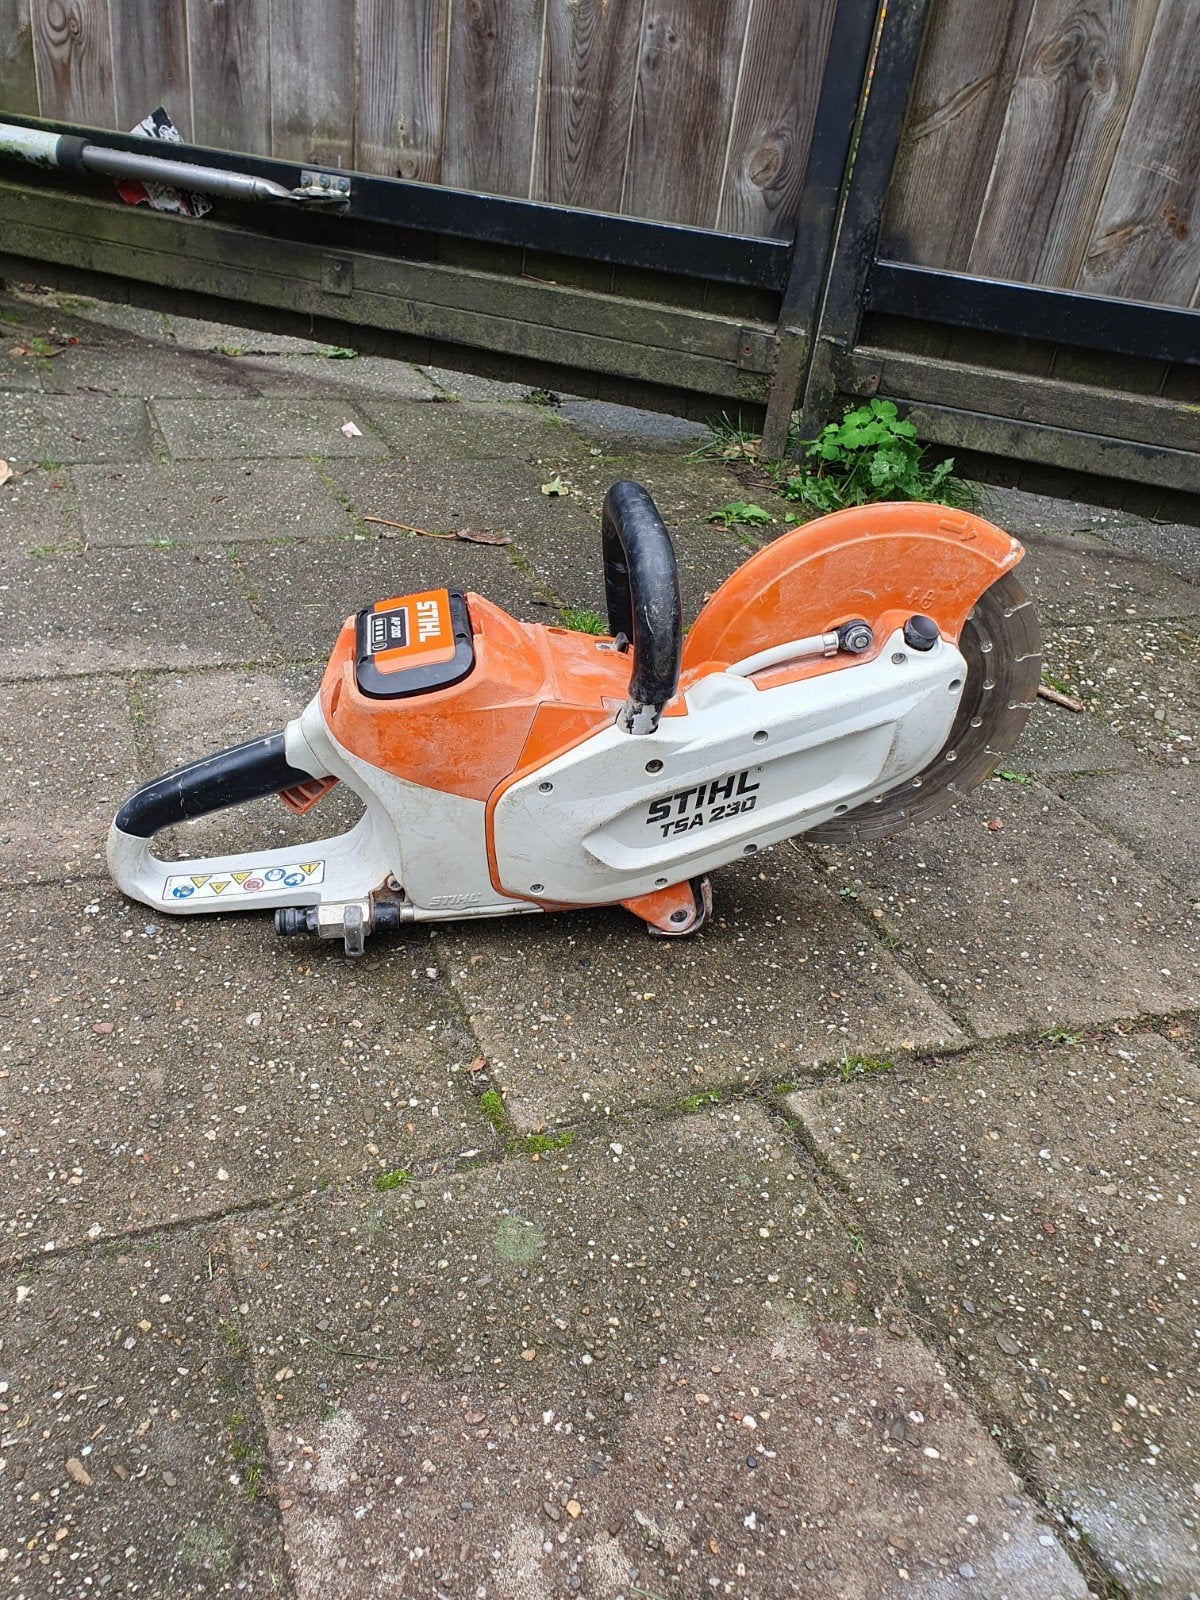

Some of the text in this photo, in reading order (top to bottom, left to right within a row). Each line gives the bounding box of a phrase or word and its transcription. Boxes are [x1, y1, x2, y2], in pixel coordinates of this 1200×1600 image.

[390, 616, 402, 639] AP 200
[416, 600, 441, 643] STIHL
[646, 771, 760, 824] STIHL
[660, 796, 757, 838] TSA 230
[428, 893, 480, 906] STIHL
